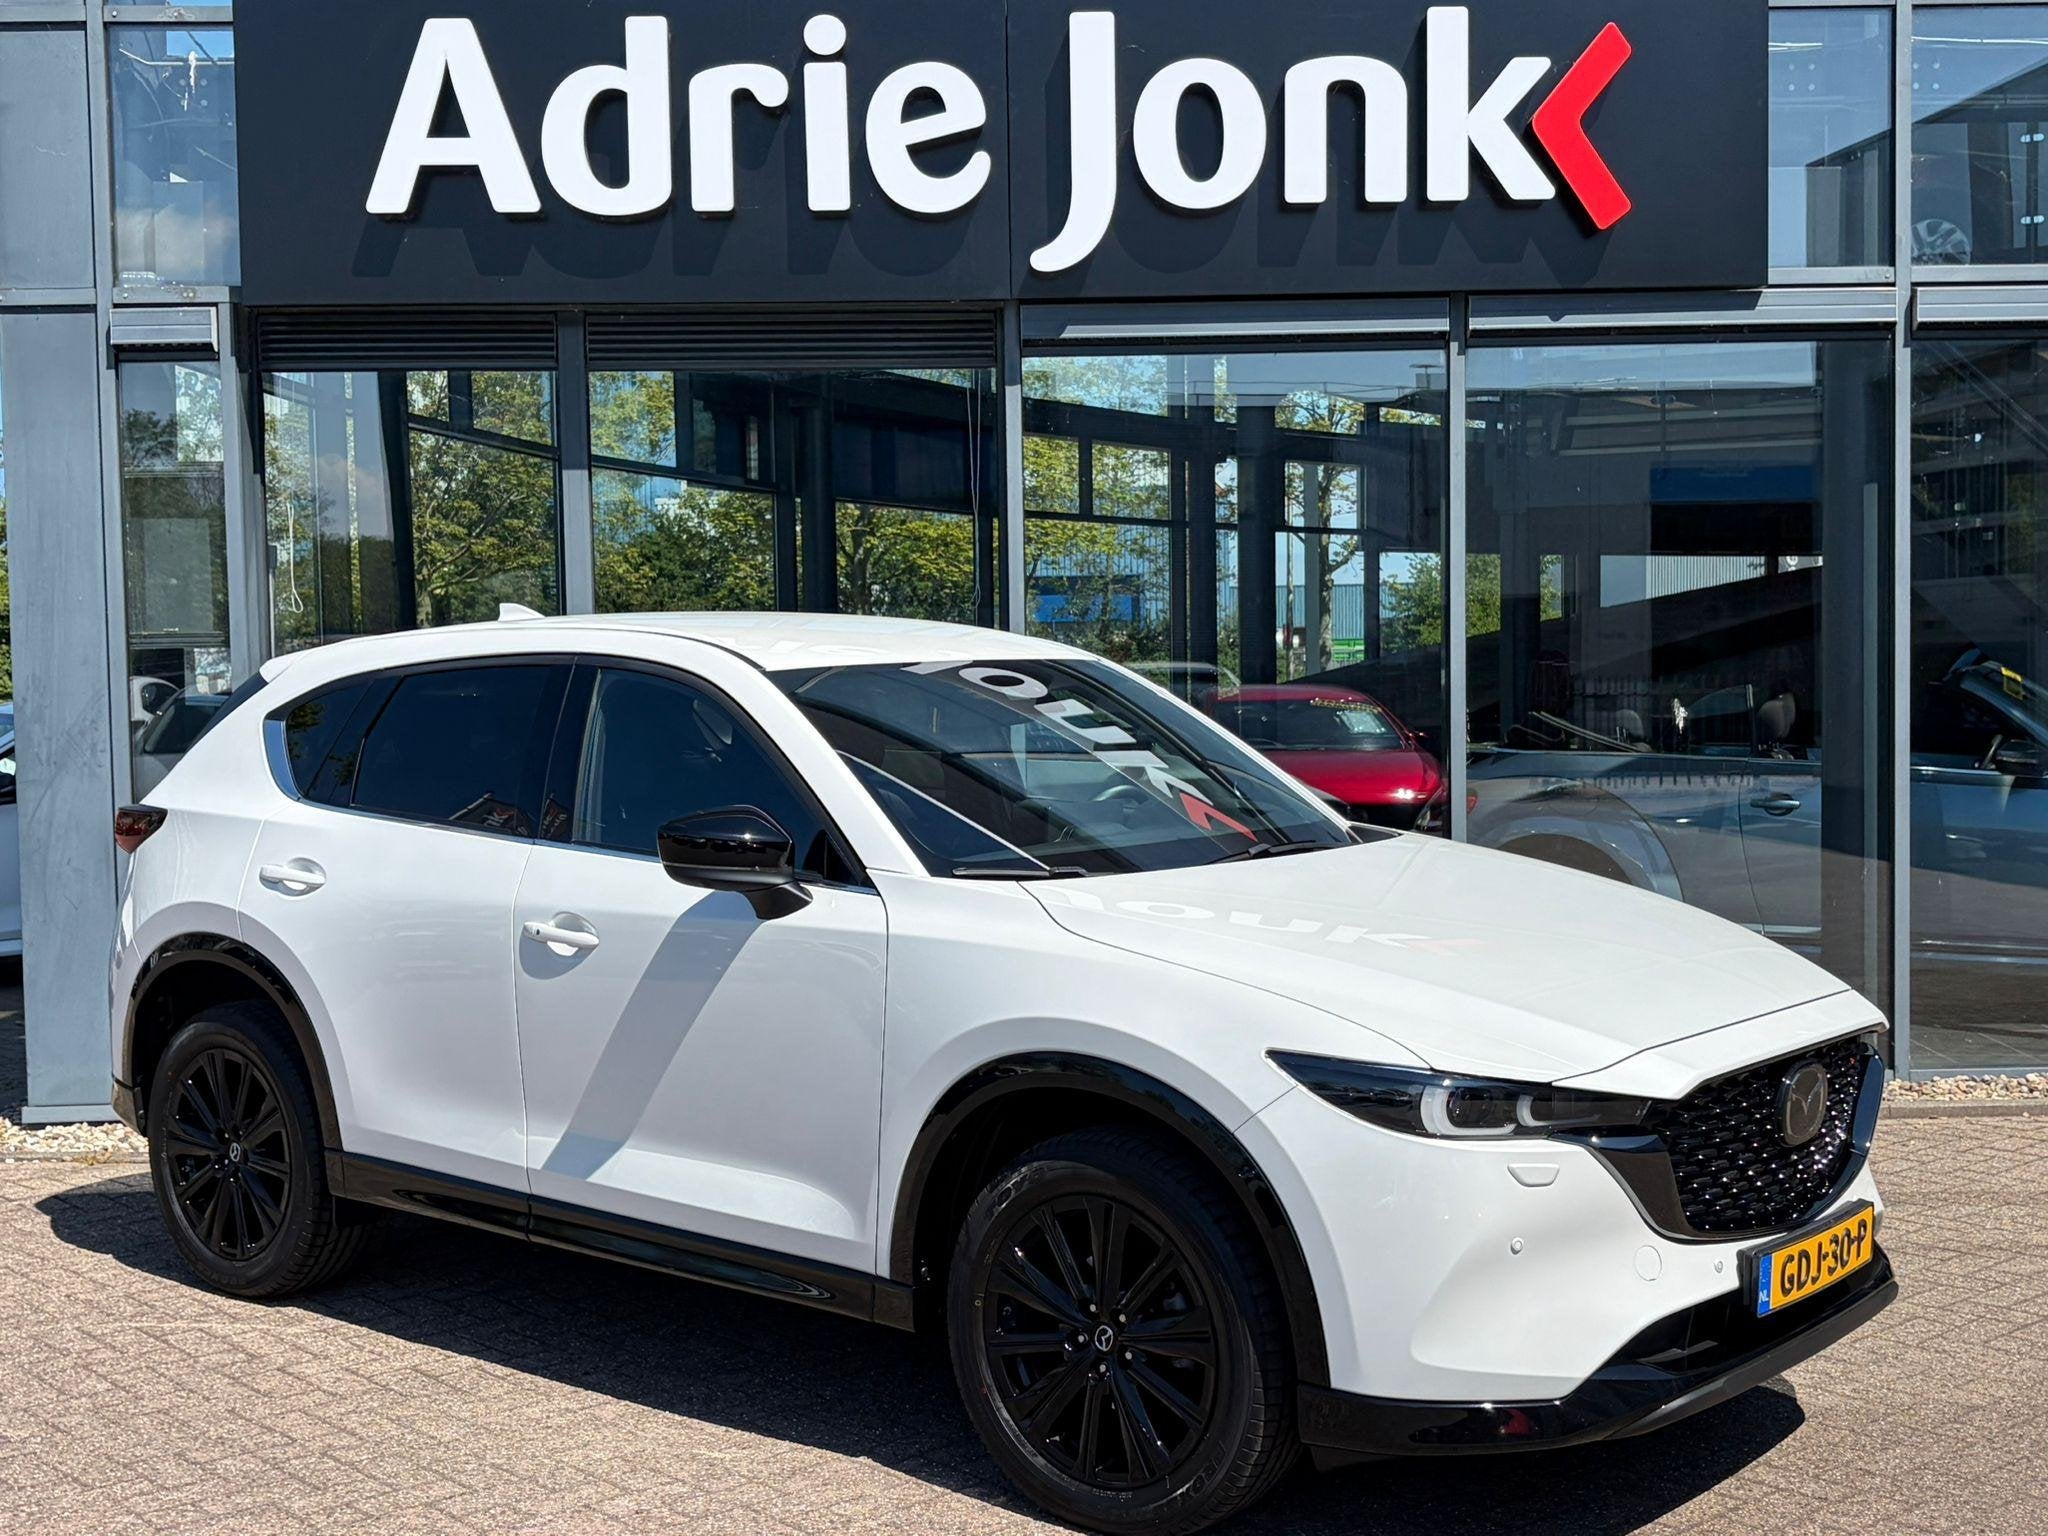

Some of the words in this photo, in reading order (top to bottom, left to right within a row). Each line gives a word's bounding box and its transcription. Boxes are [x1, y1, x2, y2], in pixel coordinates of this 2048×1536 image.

[366, 14, 991, 216] Adrie
[1029, 6, 1556, 272] Jonk
[1780, 1218, 1867, 1298] GDJ-30-P
